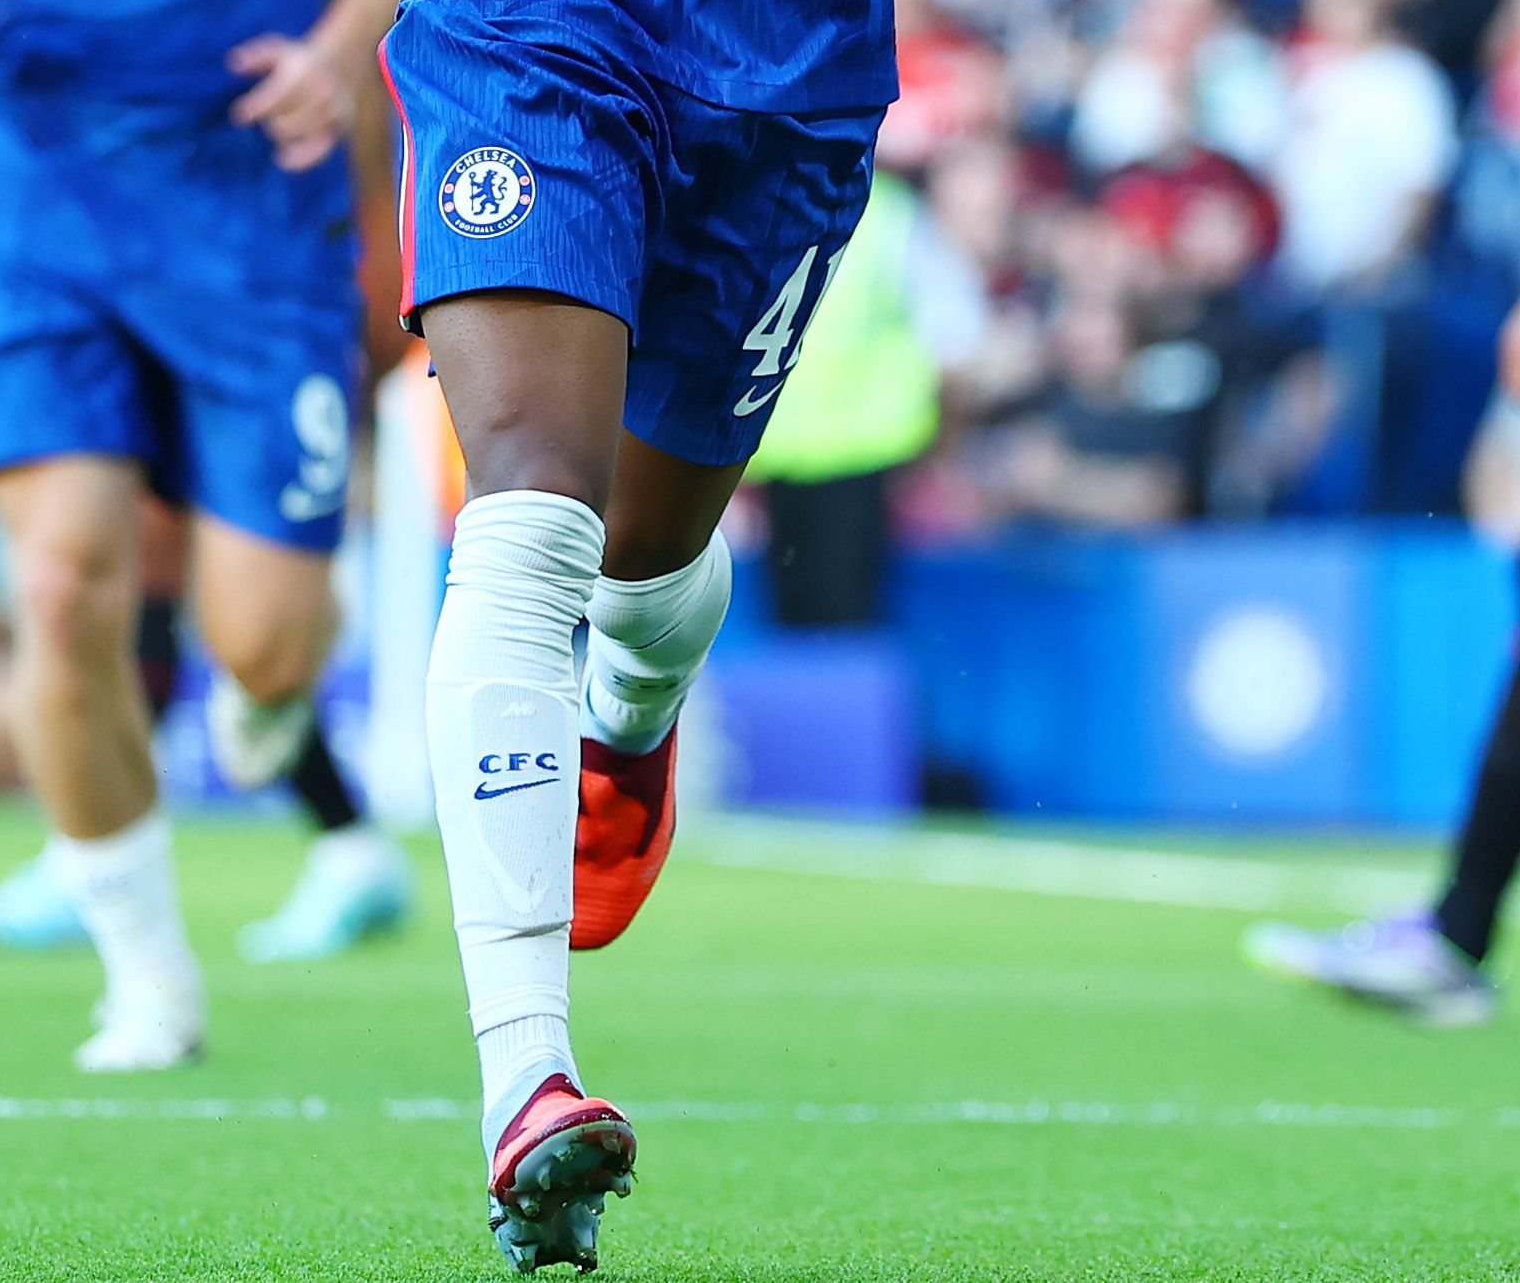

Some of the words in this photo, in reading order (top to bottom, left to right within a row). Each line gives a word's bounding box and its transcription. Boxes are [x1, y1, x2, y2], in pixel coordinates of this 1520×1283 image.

[455, 150, 516, 173] CHELSEA
[454, 219, 495, 233] FOOTBALL
[497, 214, 518, 229] CLUB
[479, 753, 560, 774] CFC
